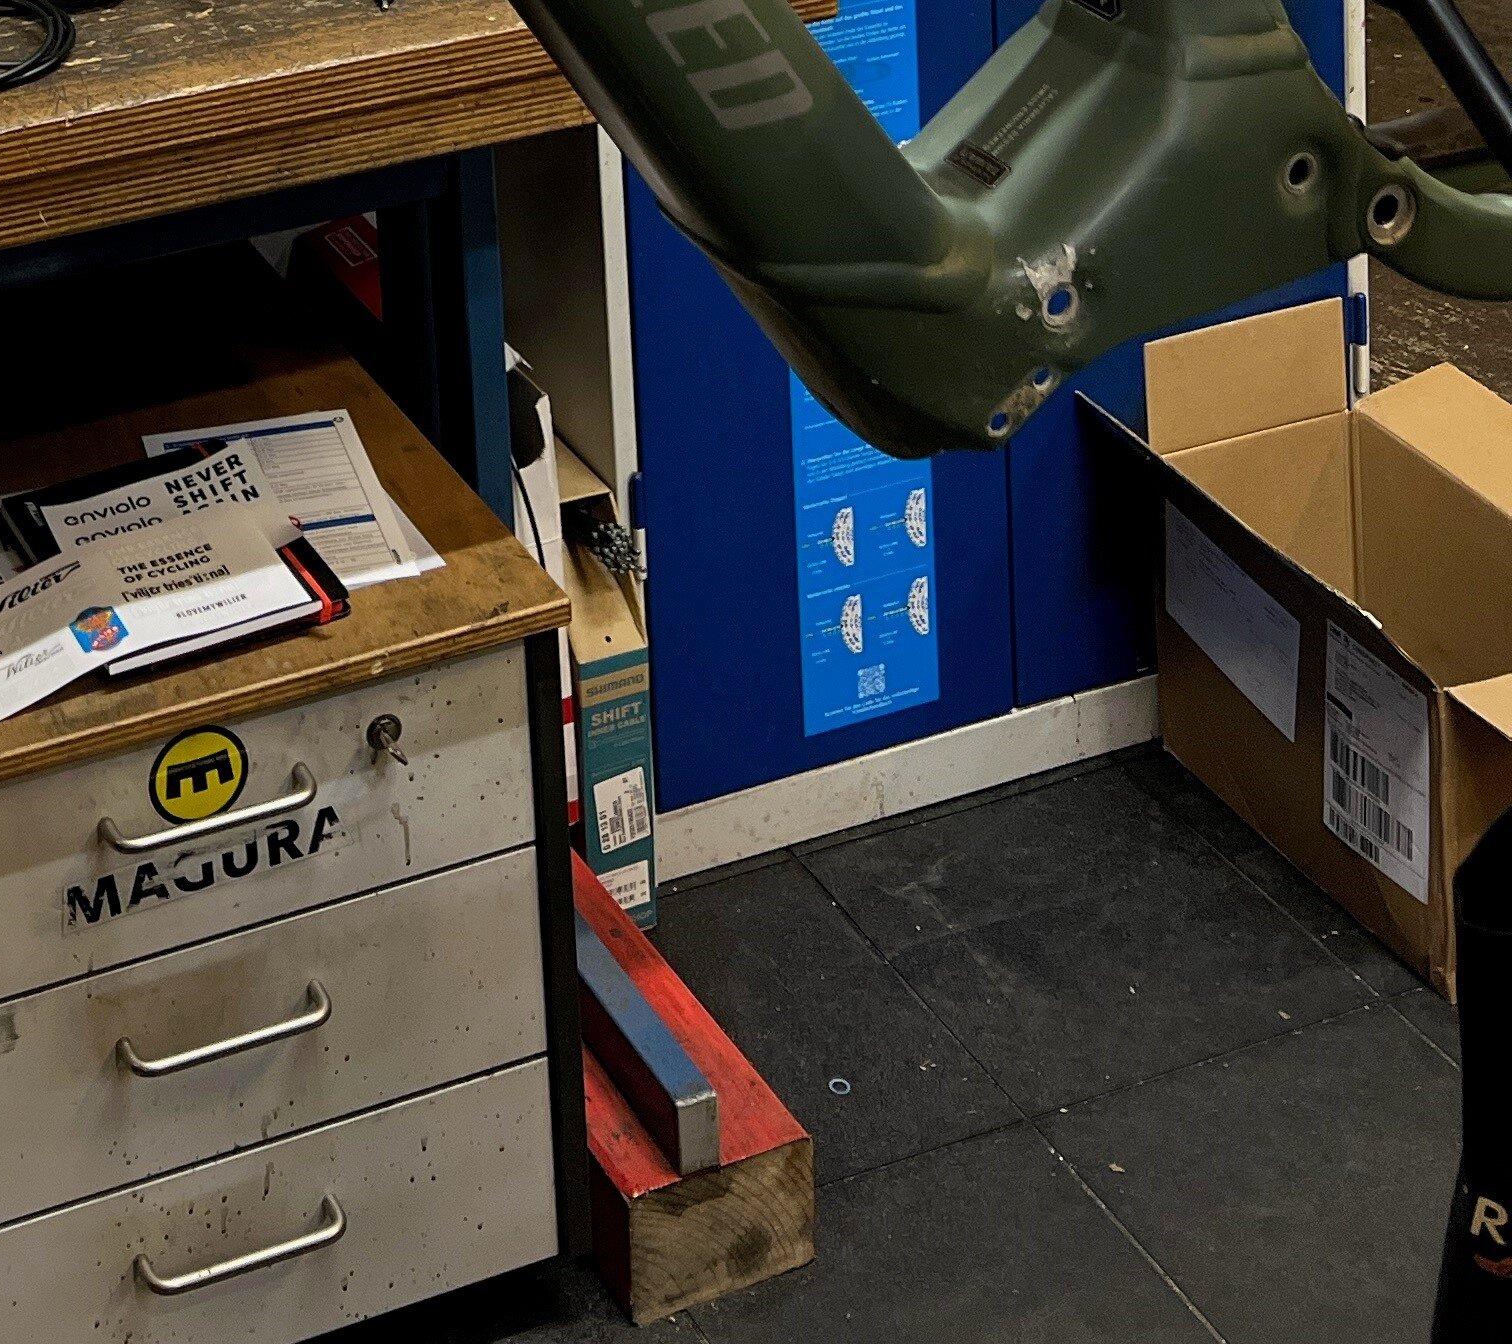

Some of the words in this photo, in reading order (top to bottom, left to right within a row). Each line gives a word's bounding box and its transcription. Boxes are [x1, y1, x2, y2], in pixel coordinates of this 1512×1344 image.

[164, 453, 244, 495] NEVER
[173, 469, 249, 509] SHIFT
[116, 561, 148, 576] THE
[148, 542, 214, 569] ESSENCE
[123, 571, 145, 584] OF
[146, 555, 211, 579] CYCLING
[586, 672, 645, 698] SHIMANO
[590, 701, 644, 727] SHIFT
[65, 804, 348, 927] MAGURA
